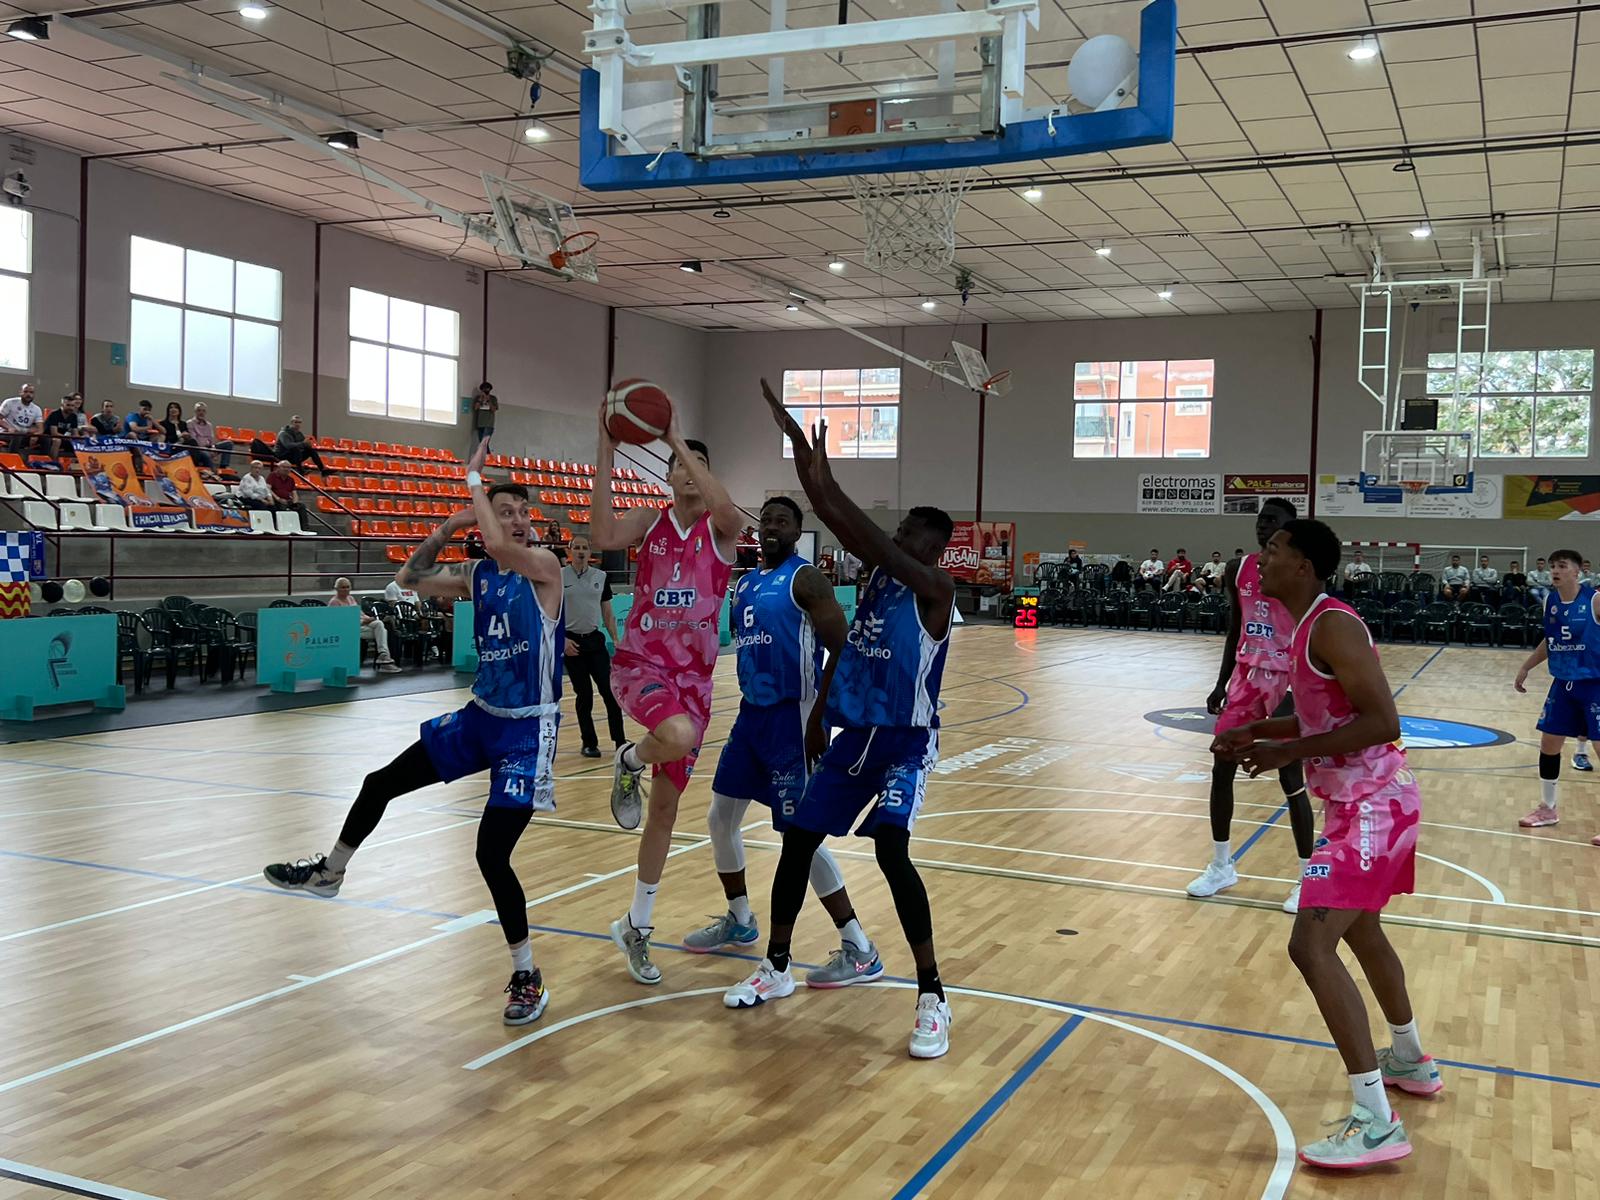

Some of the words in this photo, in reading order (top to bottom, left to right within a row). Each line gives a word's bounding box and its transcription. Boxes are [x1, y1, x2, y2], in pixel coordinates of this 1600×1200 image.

[1143, 475, 1216, 487] electromas
[1247, 480, 1272, 488] PALS
[942, 548, 978, 567] JUGAM
[655, 589, 695, 607] CBT
[487, 612, 511, 639] 41
[743, 605, 754, 628] 6
[1245, 622, 1273, 639] CBT
[1561, 626, 1572, 640] 5
[503, 778, 525, 796] 41
[877, 789, 903, 808] 25
[782, 800, 795, 816] 6
